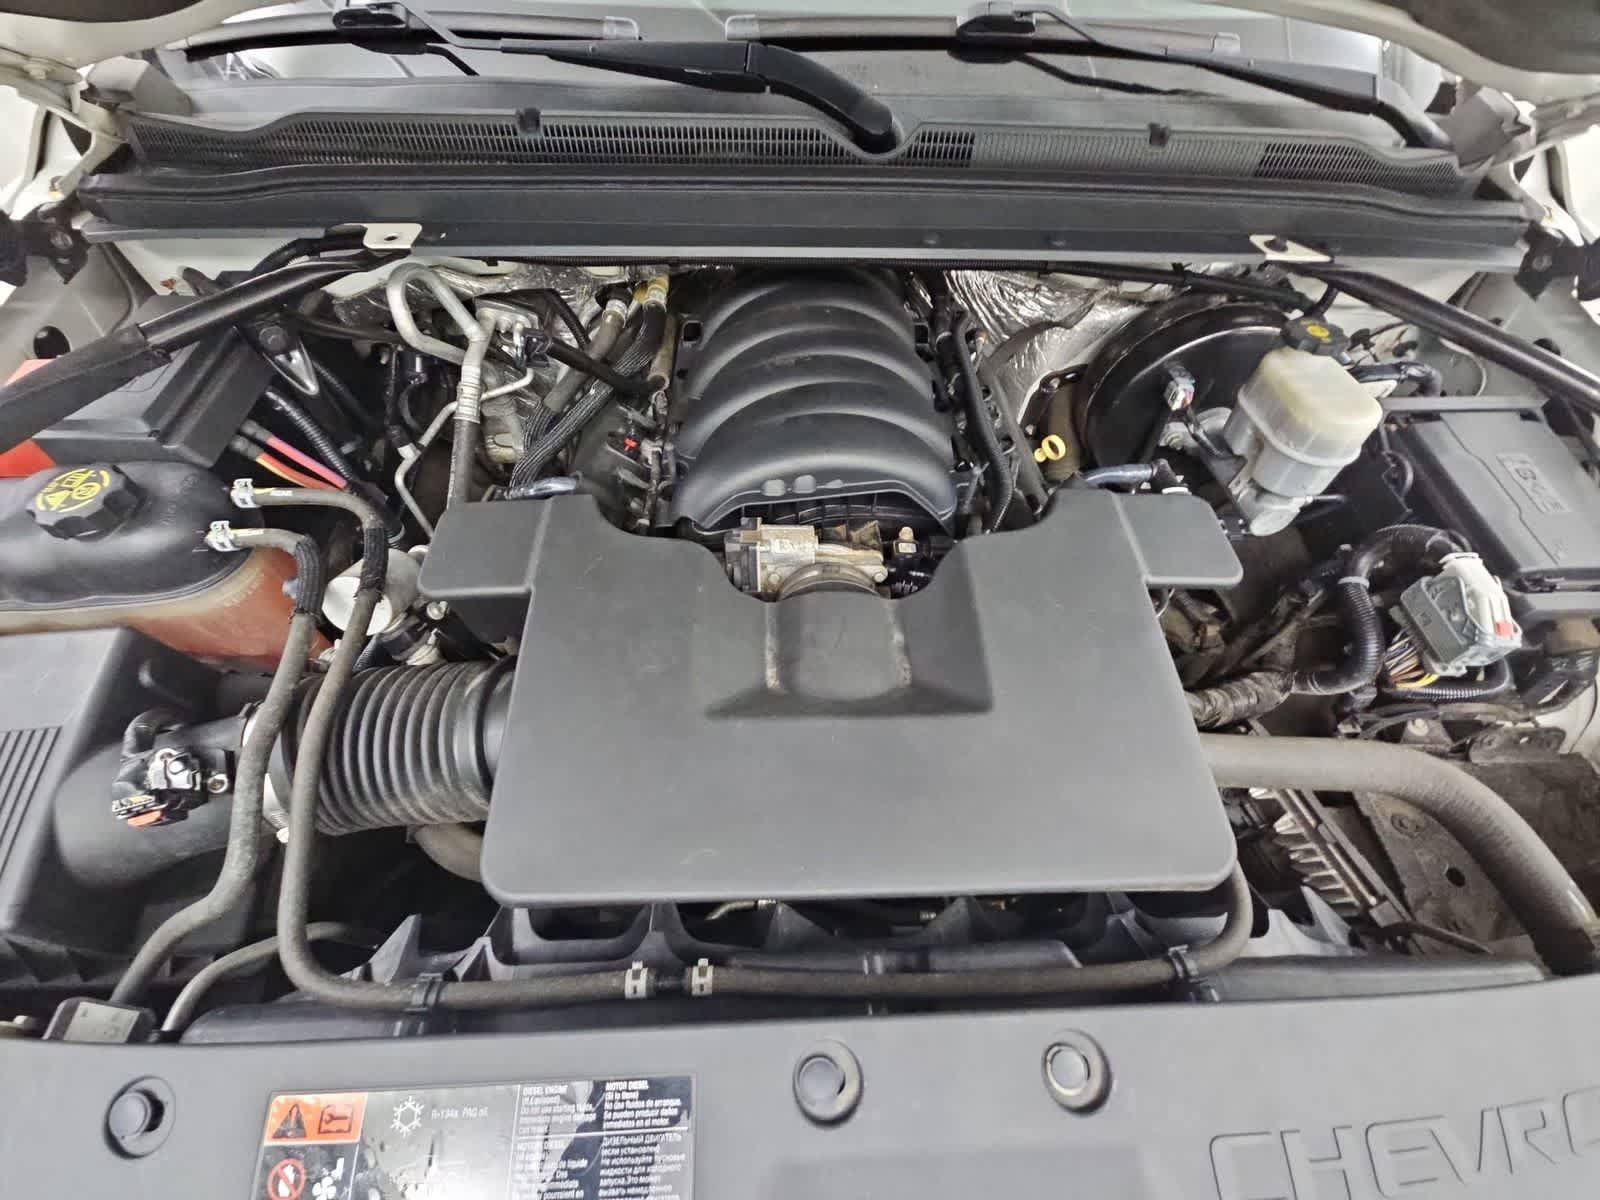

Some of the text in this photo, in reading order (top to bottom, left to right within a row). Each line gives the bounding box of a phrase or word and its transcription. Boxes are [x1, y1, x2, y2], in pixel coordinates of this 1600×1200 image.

[523, 1086, 544, 1096] DIESEL
[605, 1080, 649, 1091] MOTOR DIESEL
[625, 1100, 645, 1109] fluidos
[646, 1099, 654, 1108] de
[462, 1106, 477, 1118] PAG
[613, 1110, 634, 1120] pueden
[635, 1109, 659, 1119] producir
[602, 1133, 682, 1146] ДИЗЕЛЬНЫЙ ДВИГАТЕЛЬ
